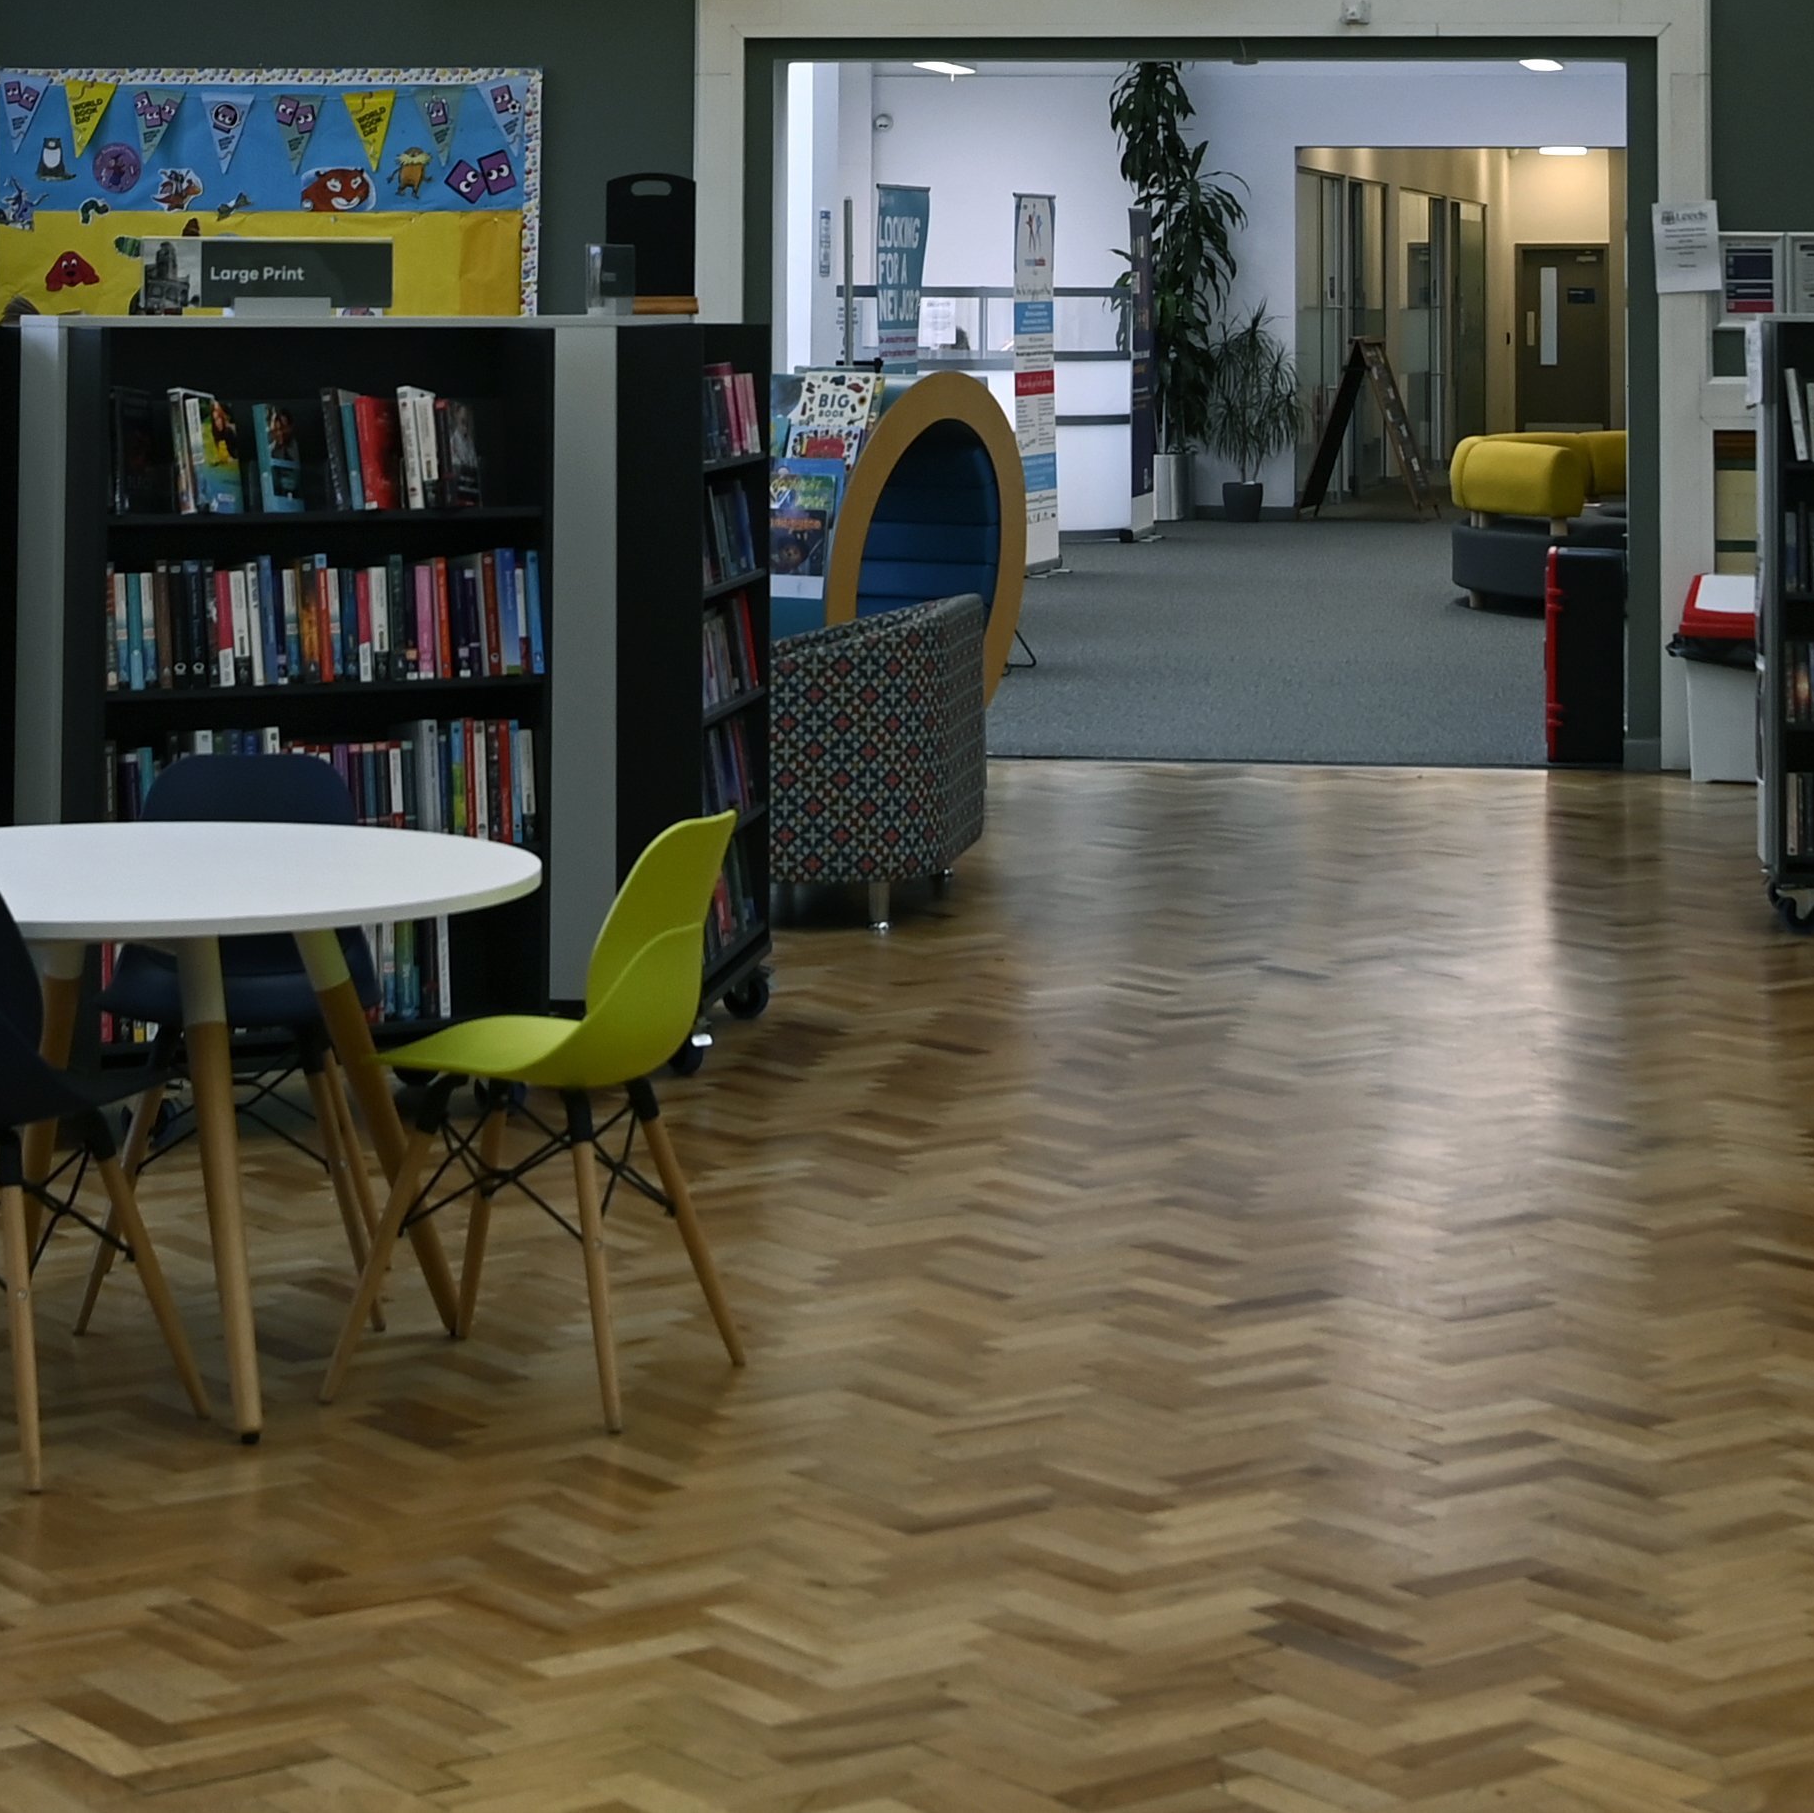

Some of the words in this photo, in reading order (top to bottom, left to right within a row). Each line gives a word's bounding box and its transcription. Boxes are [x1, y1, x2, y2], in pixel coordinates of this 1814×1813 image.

[72, 98, 103, 110] WORLD
[74, 107, 98, 118] BOOK
[356, 106, 386, 124] WORLD
[76, 115, 91, 125] DAY
[360, 117, 384, 131] BOOK
[363, 125, 378, 137] DAY
[1676, 211, 1708, 221] Leeds
[879, 216, 921, 248] LOOKING
[210, 265, 261, 284] Large
[266, 265, 305, 281] Print
[879, 252, 900, 285] FOR
[819, 394, 850, 408] BIG
[818, 410, 844, 418] BOOK
